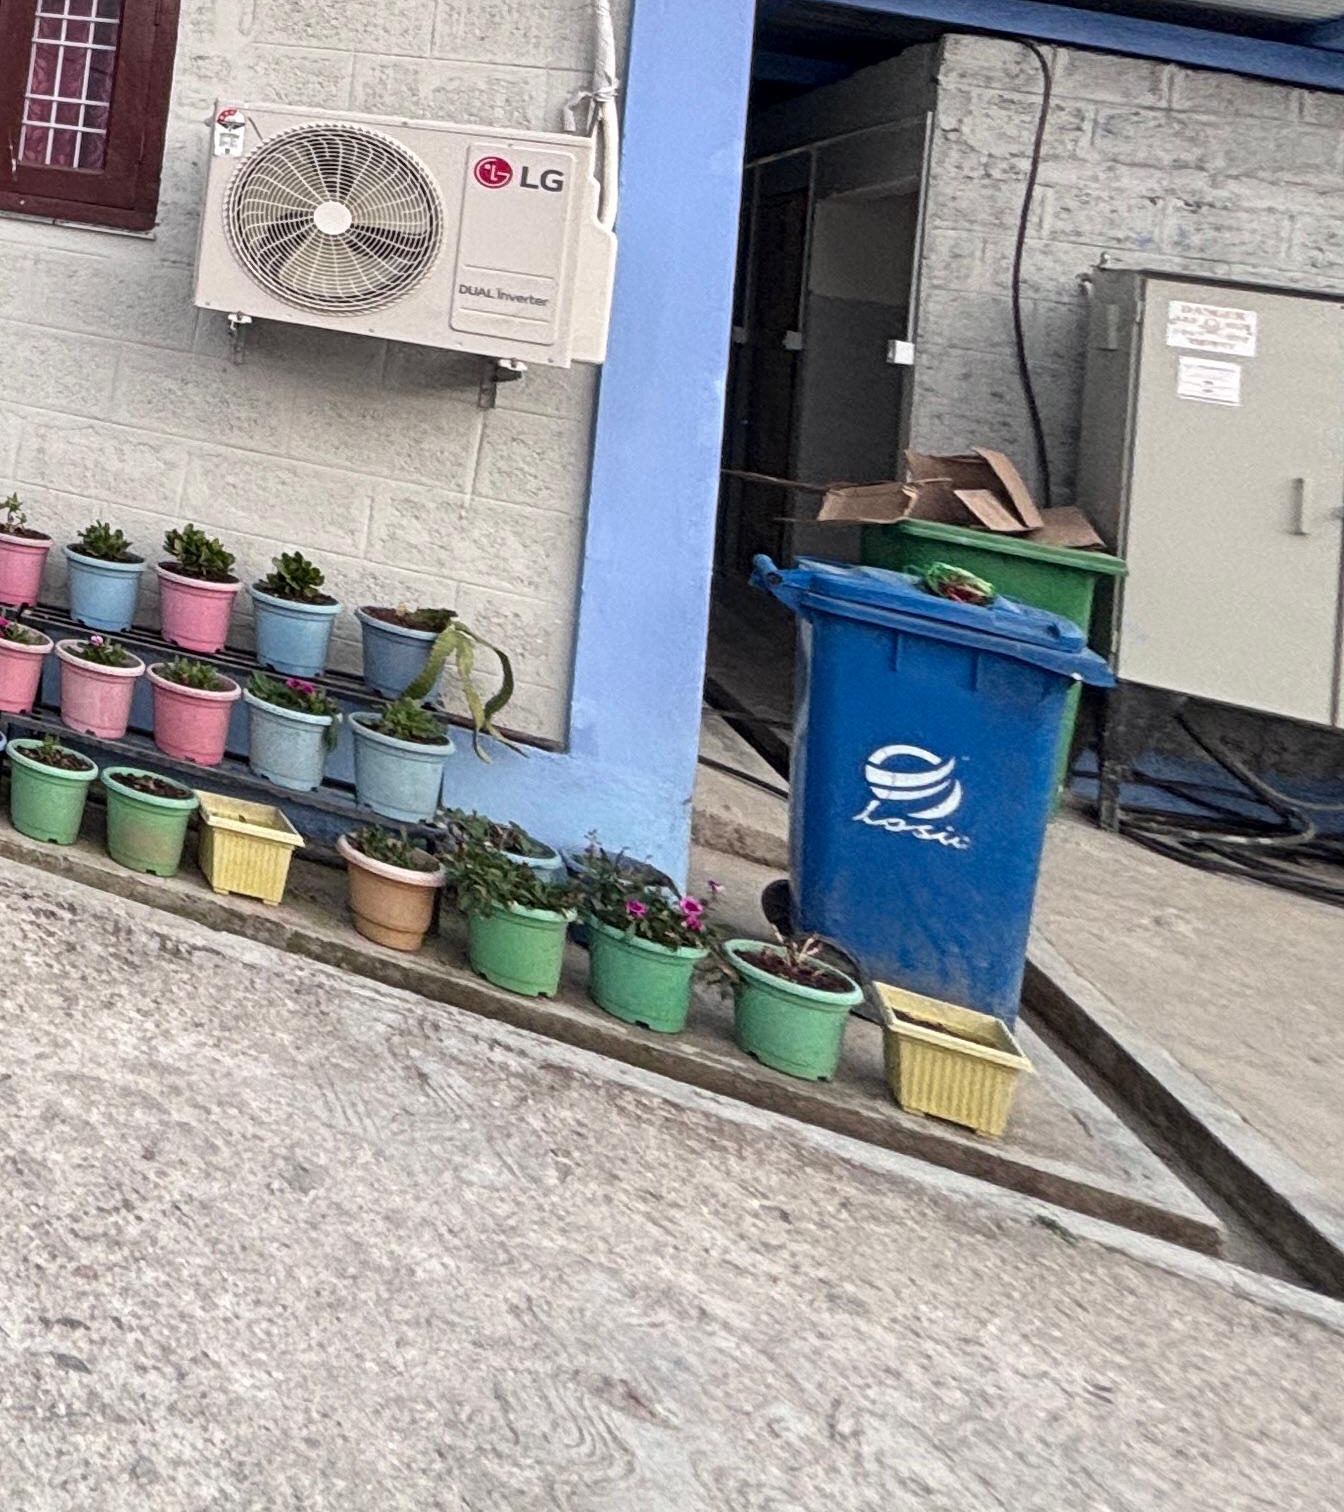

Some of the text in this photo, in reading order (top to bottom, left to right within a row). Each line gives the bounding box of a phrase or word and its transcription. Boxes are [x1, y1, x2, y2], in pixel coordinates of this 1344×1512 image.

[519, 166, 565, 192] LG
[458, 284, 549, 306] DUAL Inverter
